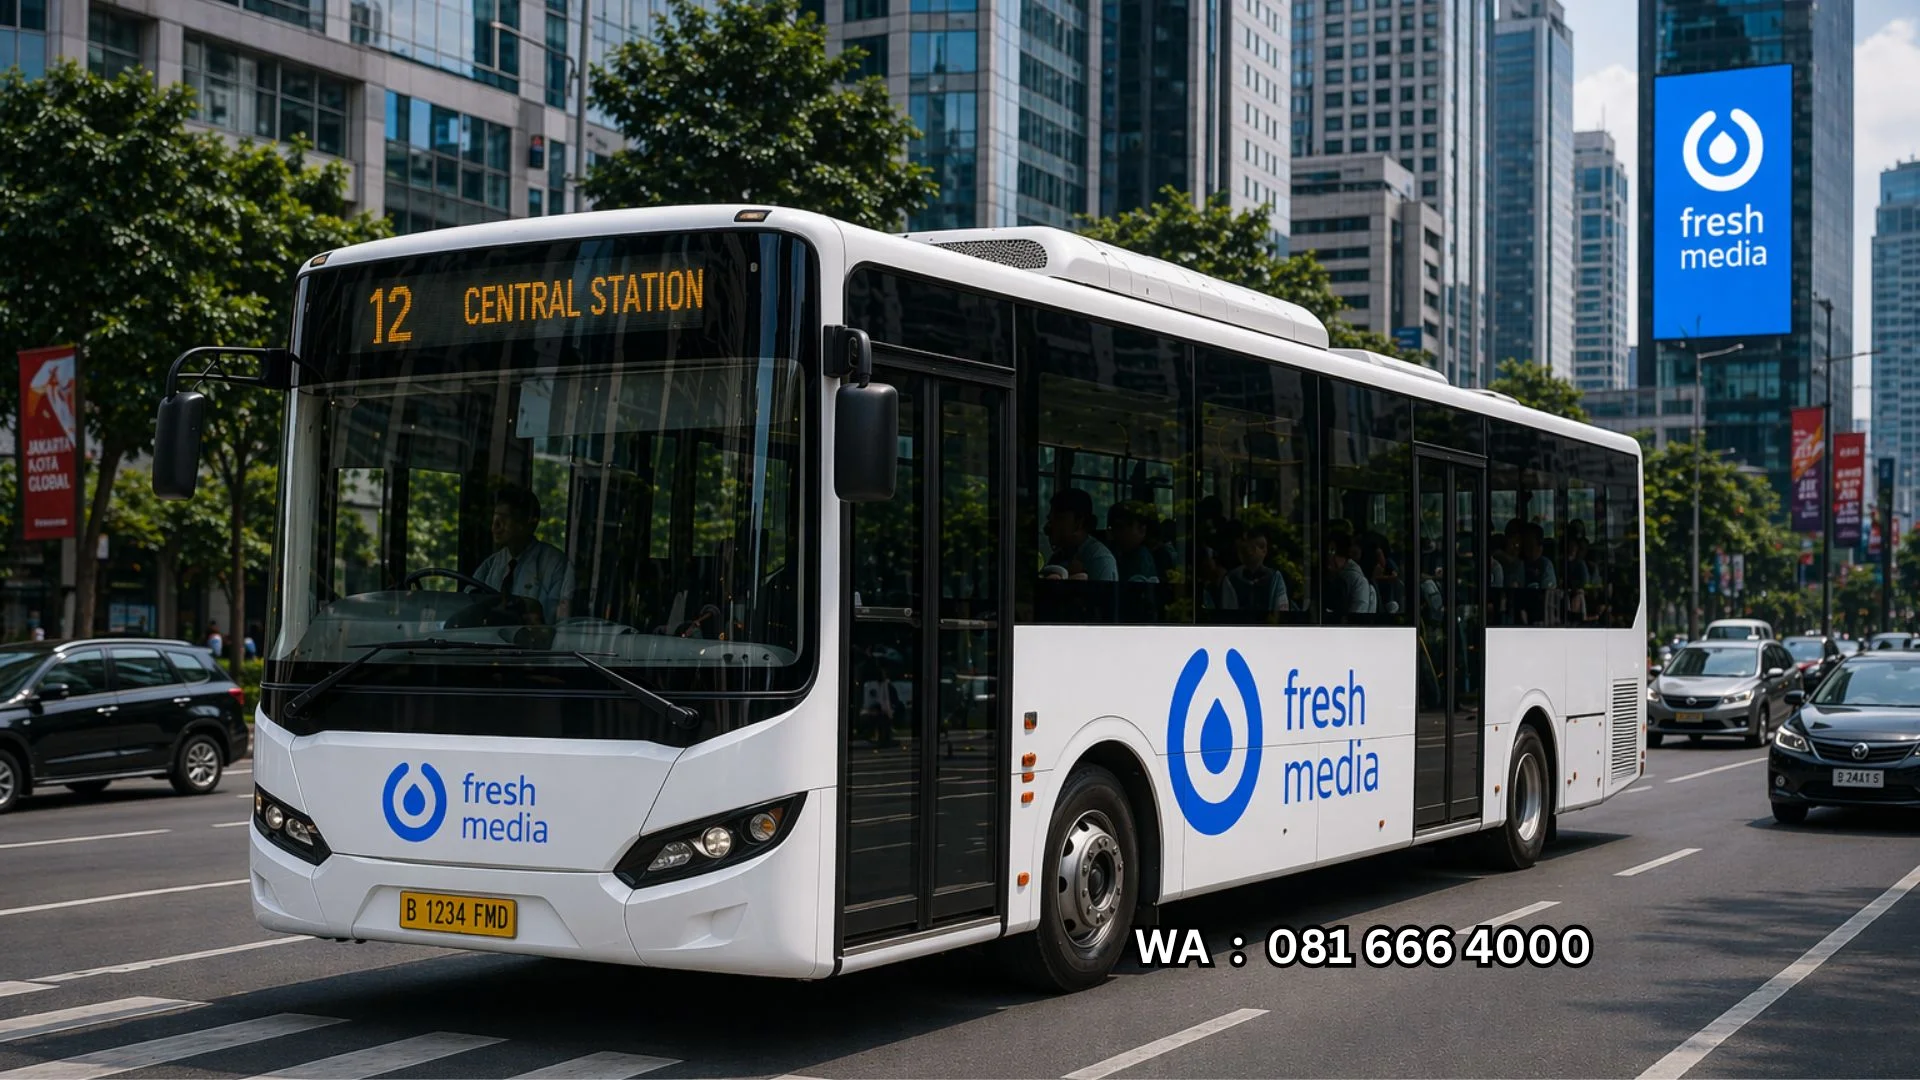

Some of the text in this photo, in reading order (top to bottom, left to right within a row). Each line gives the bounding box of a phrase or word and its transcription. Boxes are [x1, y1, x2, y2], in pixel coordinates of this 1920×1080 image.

[1680, 203, 1764, 238] fresh
[1680, 239, 1767, 270] media
[369, 268, 704, 345] 12 CENTRAL STATION
[28, 456, 60, 473] KOTA
[28, 473, 71, 493] GLOBAL
[1284, 668, 1366, 731] fresh
[1283, 738, 1379, 805] media
[462, 772, 536, 807] fresh
[461, 811, 549, 844] media
[406, 898, 509, 930] B 1234 FMD
